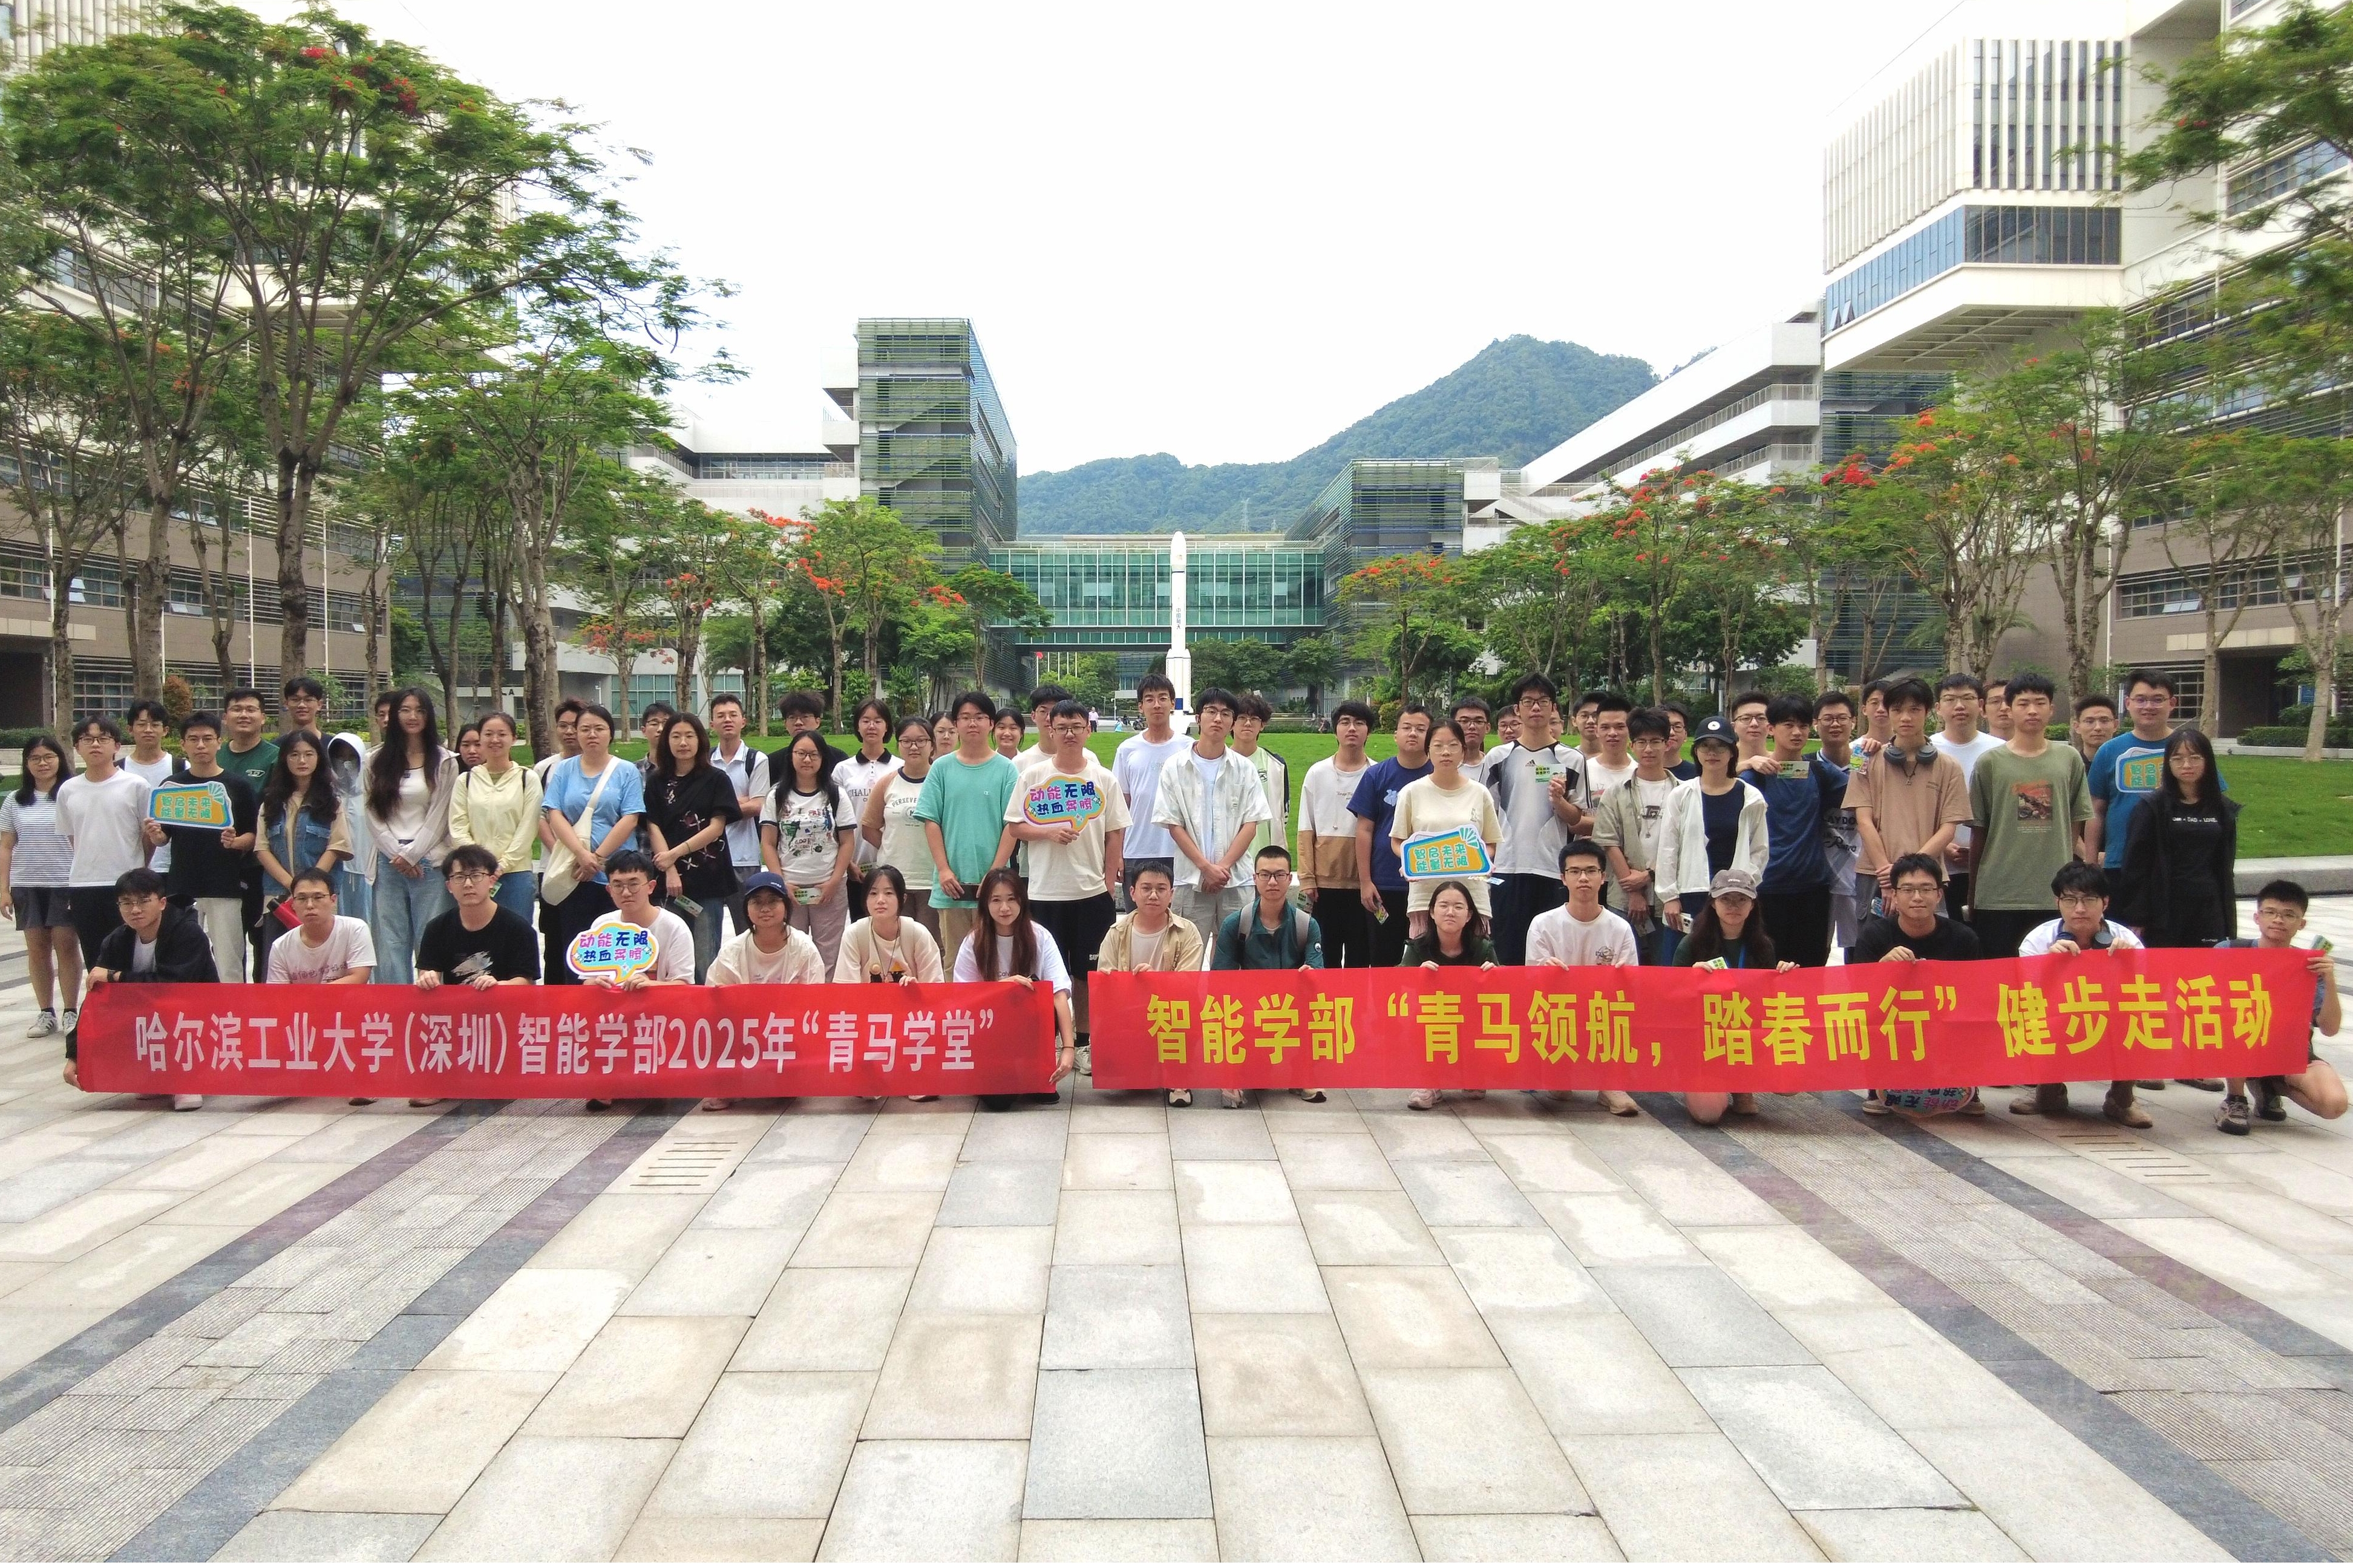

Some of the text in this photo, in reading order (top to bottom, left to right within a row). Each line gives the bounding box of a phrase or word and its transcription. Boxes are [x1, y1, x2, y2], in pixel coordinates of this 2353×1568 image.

[1030, 782, 1096, 802] 动能无限
[1037, 798, 1092, 815] 热血奔腾
[1414, 843, 1466, 860] 智启未来
[1416, 856, 1469, 872] 能量无限
[579, 930, 648, 948] 动能无限
